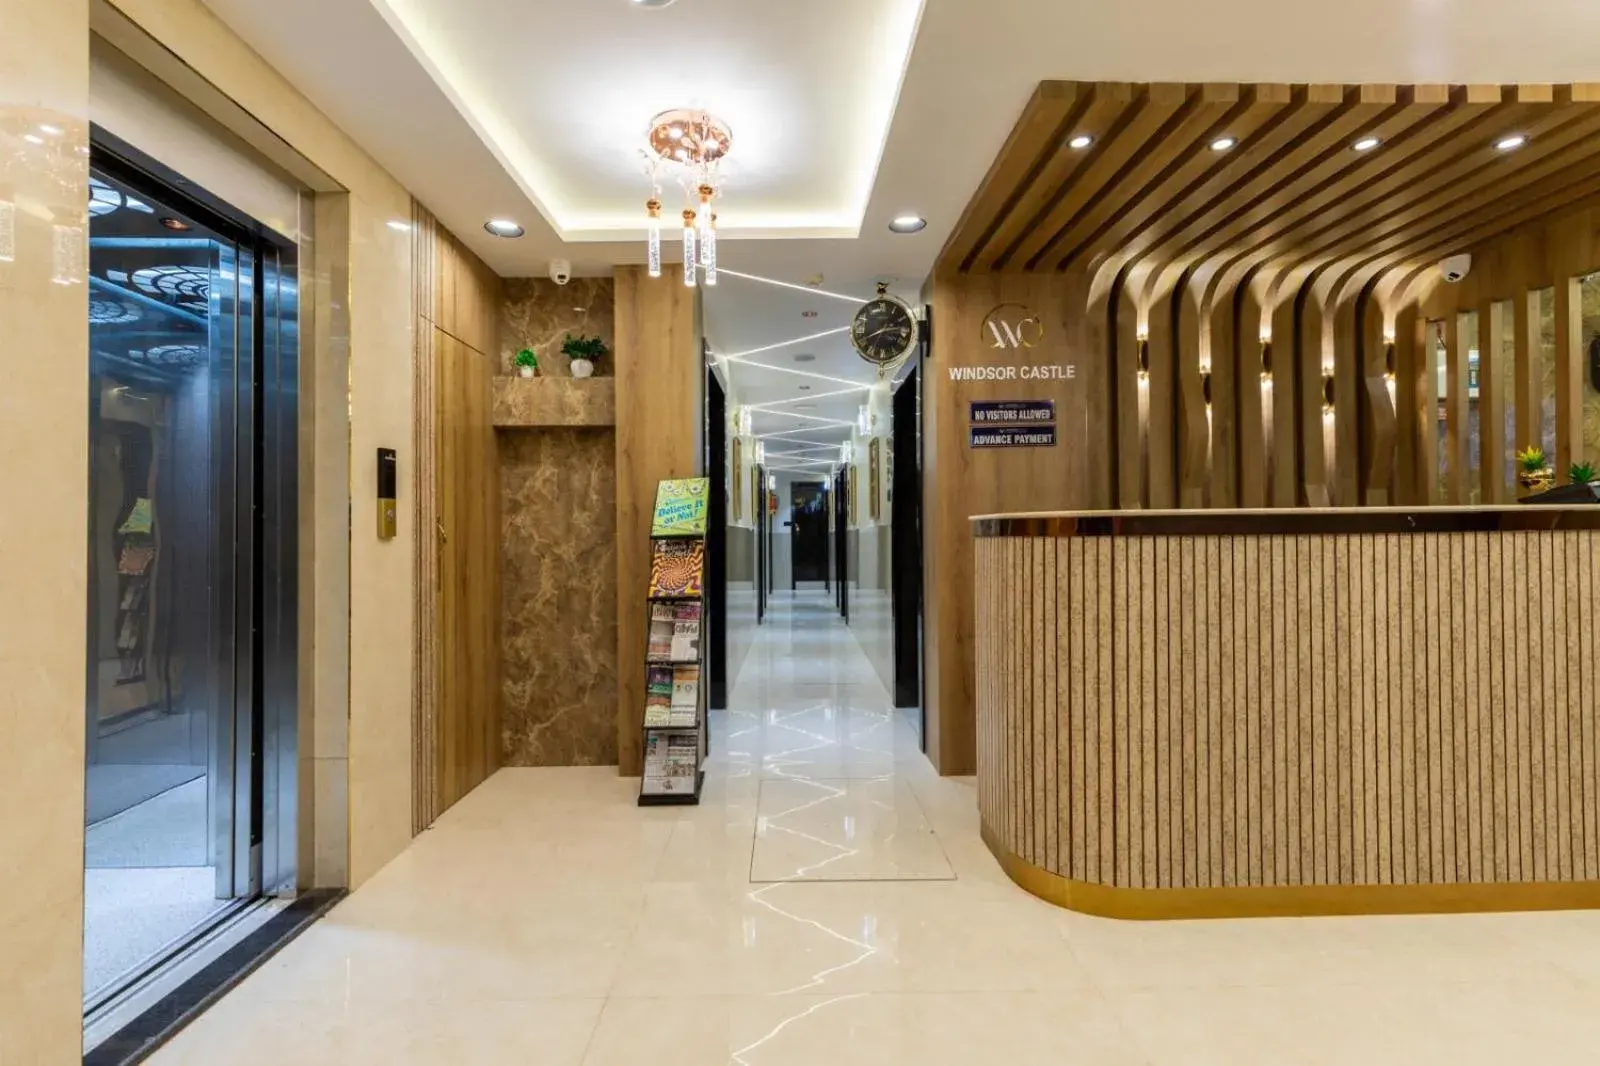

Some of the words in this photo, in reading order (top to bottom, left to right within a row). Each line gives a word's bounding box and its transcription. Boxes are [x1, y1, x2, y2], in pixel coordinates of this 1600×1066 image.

[948, 366, 1017, 380] WINDSOR
[1020, 365, 1076, 379] CASTLE
[975, 410, 985, 420] NO
[986, 410, 1017, 420] VISITORS
[1018, 409, 1051, 419] ALLOWED
[974, 434, 1012, 445] ADVANCE
[1014, 434, 1052, 444] PAYMENT
